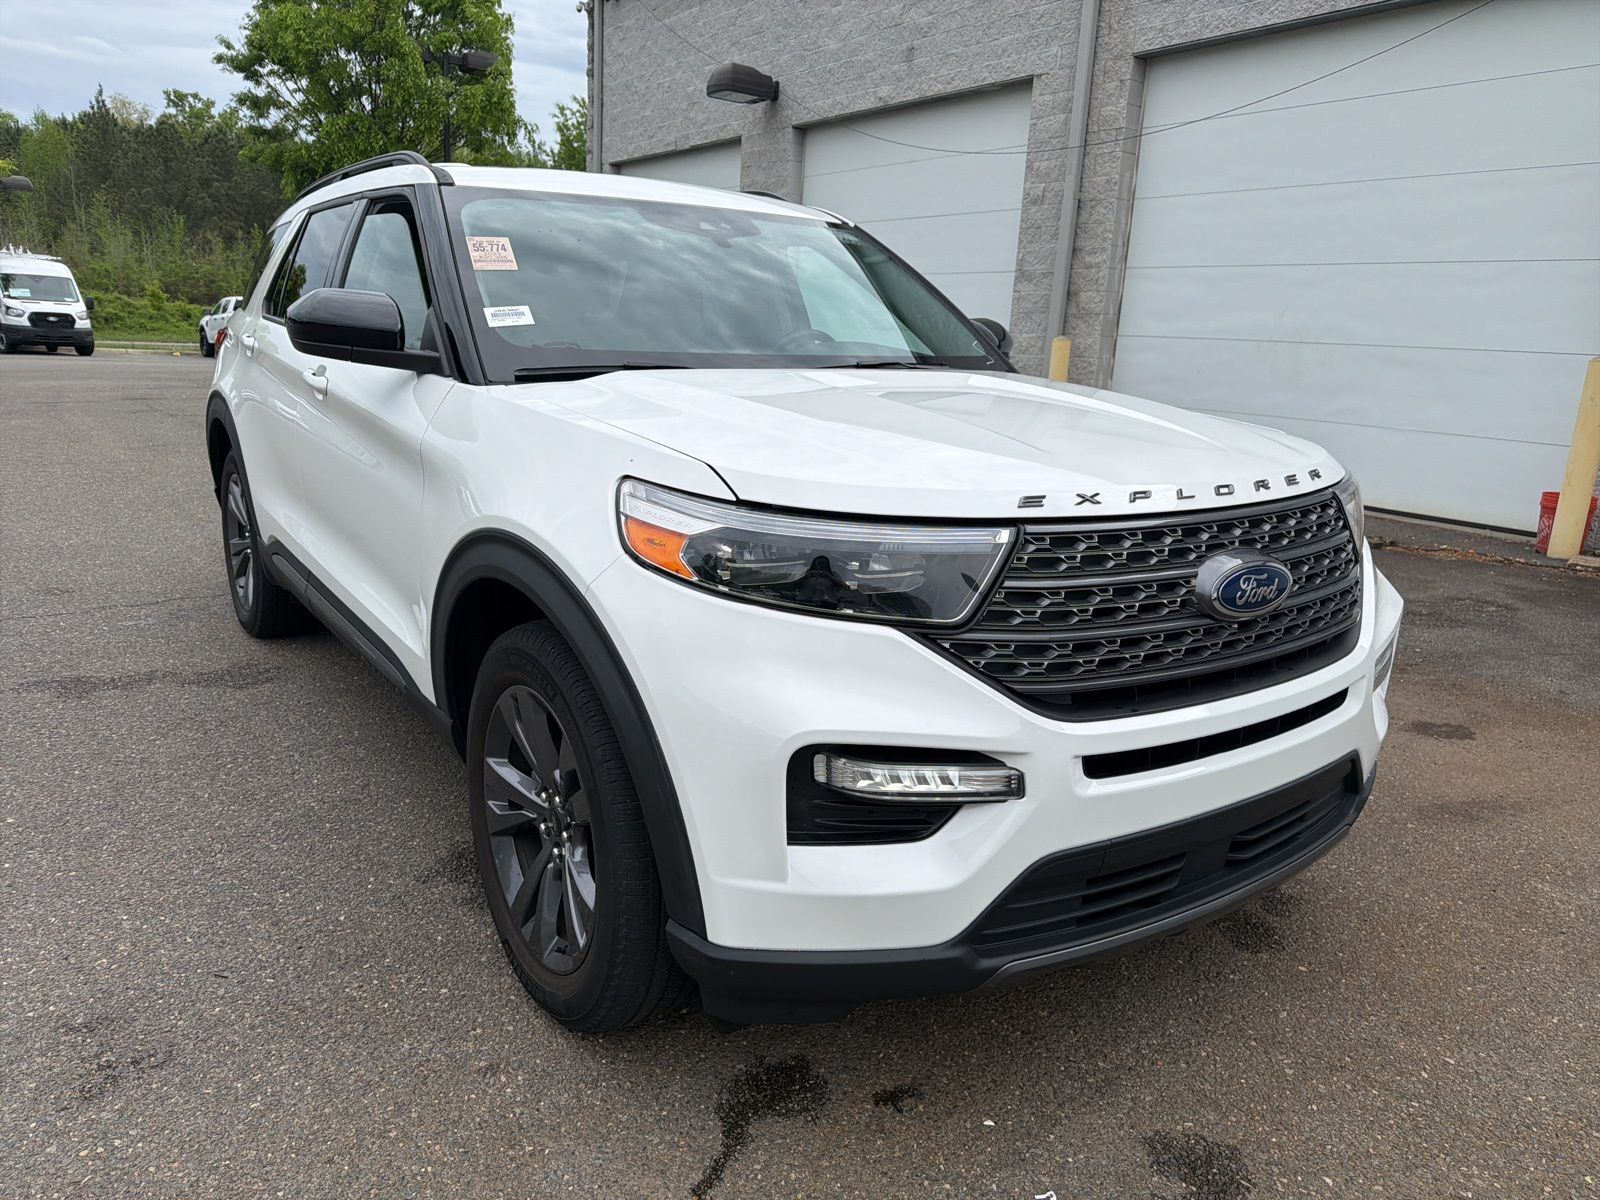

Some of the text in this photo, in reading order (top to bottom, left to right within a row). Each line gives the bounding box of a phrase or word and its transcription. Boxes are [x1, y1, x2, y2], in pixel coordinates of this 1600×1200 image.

[472, 243, 507, 252] 55:774
[1017, 468, 1322, 508] EXPLORER
[1235, 572, 1279, 606] Ford
